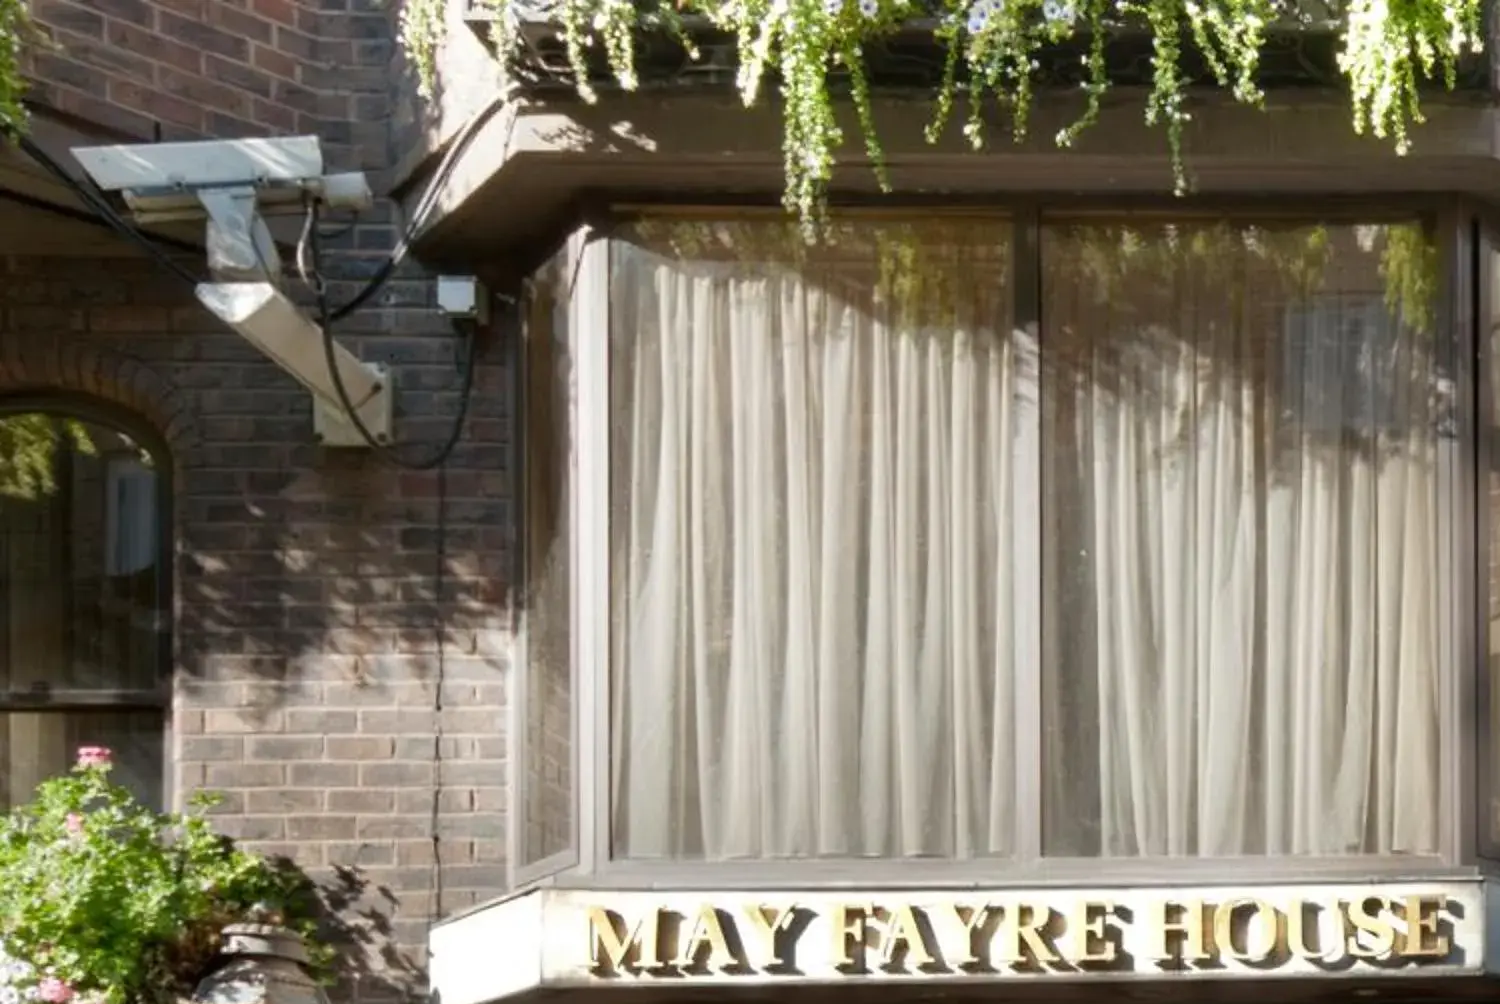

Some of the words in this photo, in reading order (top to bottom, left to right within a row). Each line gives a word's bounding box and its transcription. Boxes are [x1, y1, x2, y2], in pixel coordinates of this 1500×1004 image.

[589, 902, 798, 970] MAY
[834, 899, 1118, 967] FAYRE
[1148, 893, 1450, 962] HOUSE
